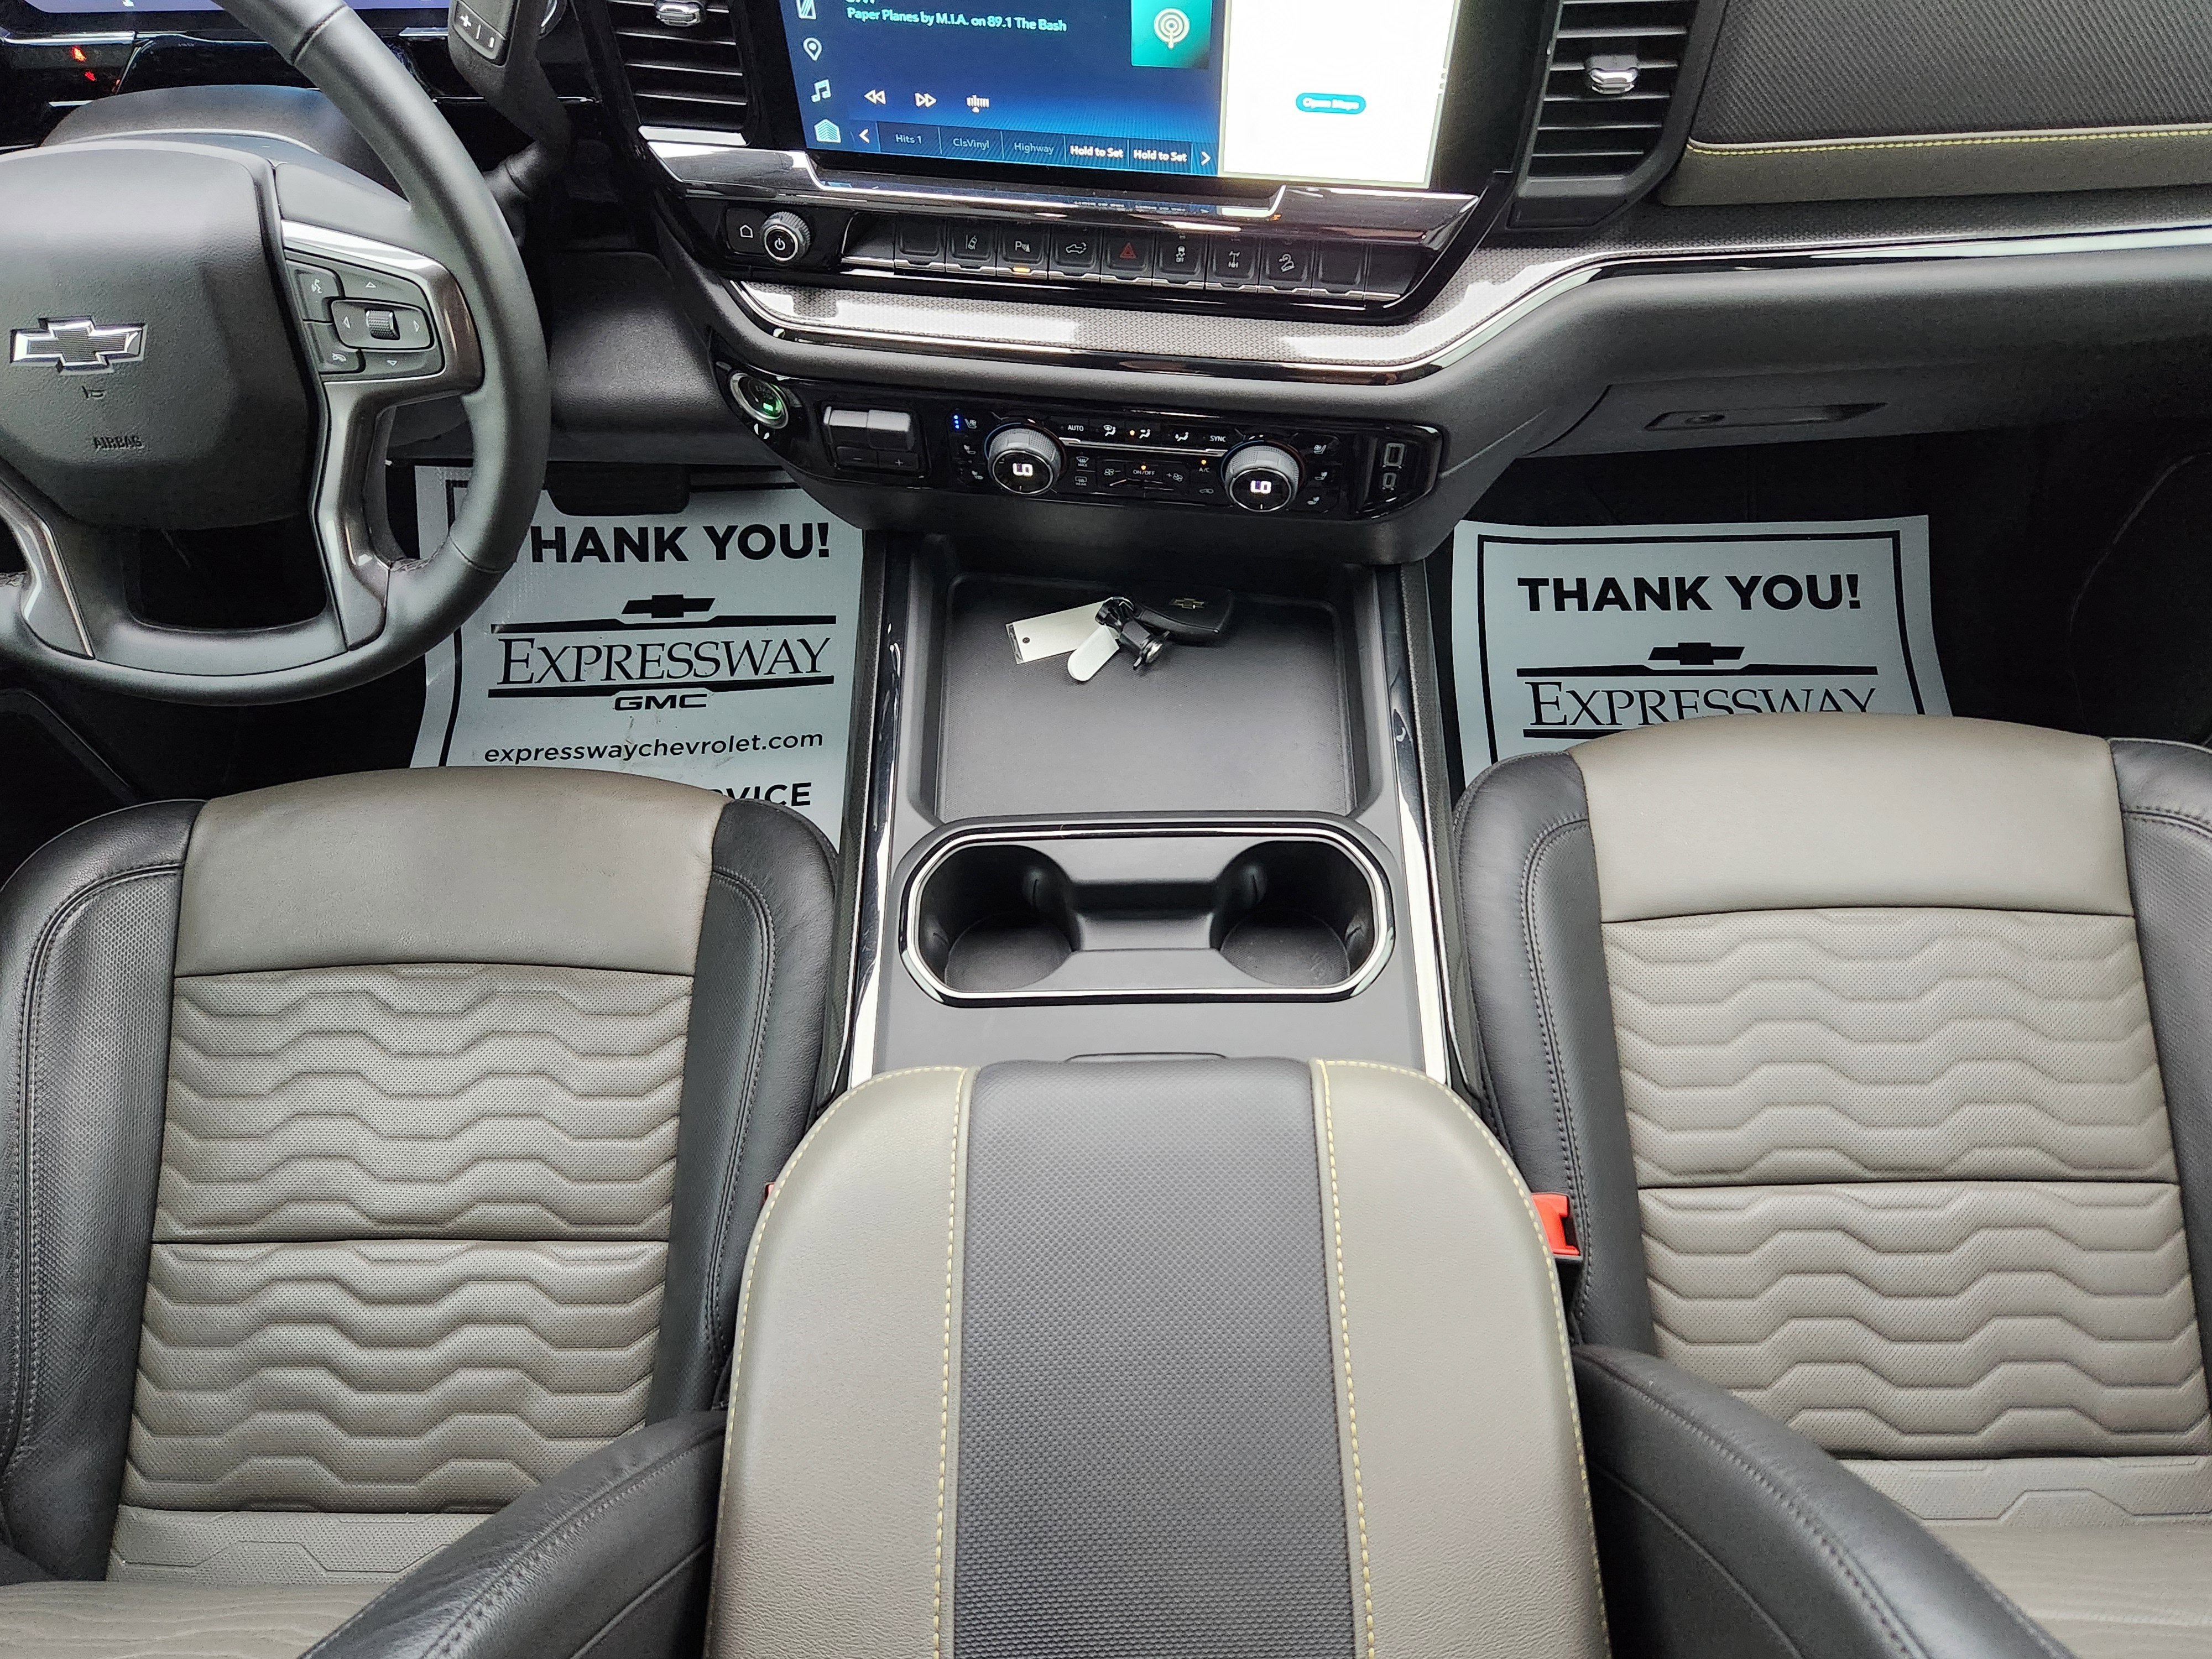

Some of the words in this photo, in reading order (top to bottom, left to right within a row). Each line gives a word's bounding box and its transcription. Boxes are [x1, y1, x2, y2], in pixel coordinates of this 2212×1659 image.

[846, 7, 880, 23] Paper
[881, 9, 920, 23] Planes
[920, 11, 935, 26] by
[971, 17, 986, 27] on
[987, 15, 1012, 28] 89.1
[1013, 17, 1037, 29] The
[1038, 18, 1067, 32] Bash
[895, 134, 915, 144] Hits
[917, 135, 922, 144] 1
[1014, 142, 1054, 155] Highway
[1070, 145, 1093, 156] Hold
[1094, 148, 1105, 157] to
[1107, 148, 1124, 158] Set
[1134, 149, 1156, 160] Hold
[1158, 152, 1169, 161] to
[1170, 152, 1187, 163] Set
[94, 435, 143, 449] AIRBAG
[531, 525, 690, 563] HANK
[701, 523, 830, 561] YOU!
[1517, 576, 1713, 612] THANK
[1725, 574, 1861, 611] YOU!
[497, 638, 831, 685] EXPRESSWAY
[614, 693, 708, 711] GMC
[484, 731, 823, 763] expresswaychevrolet.com
